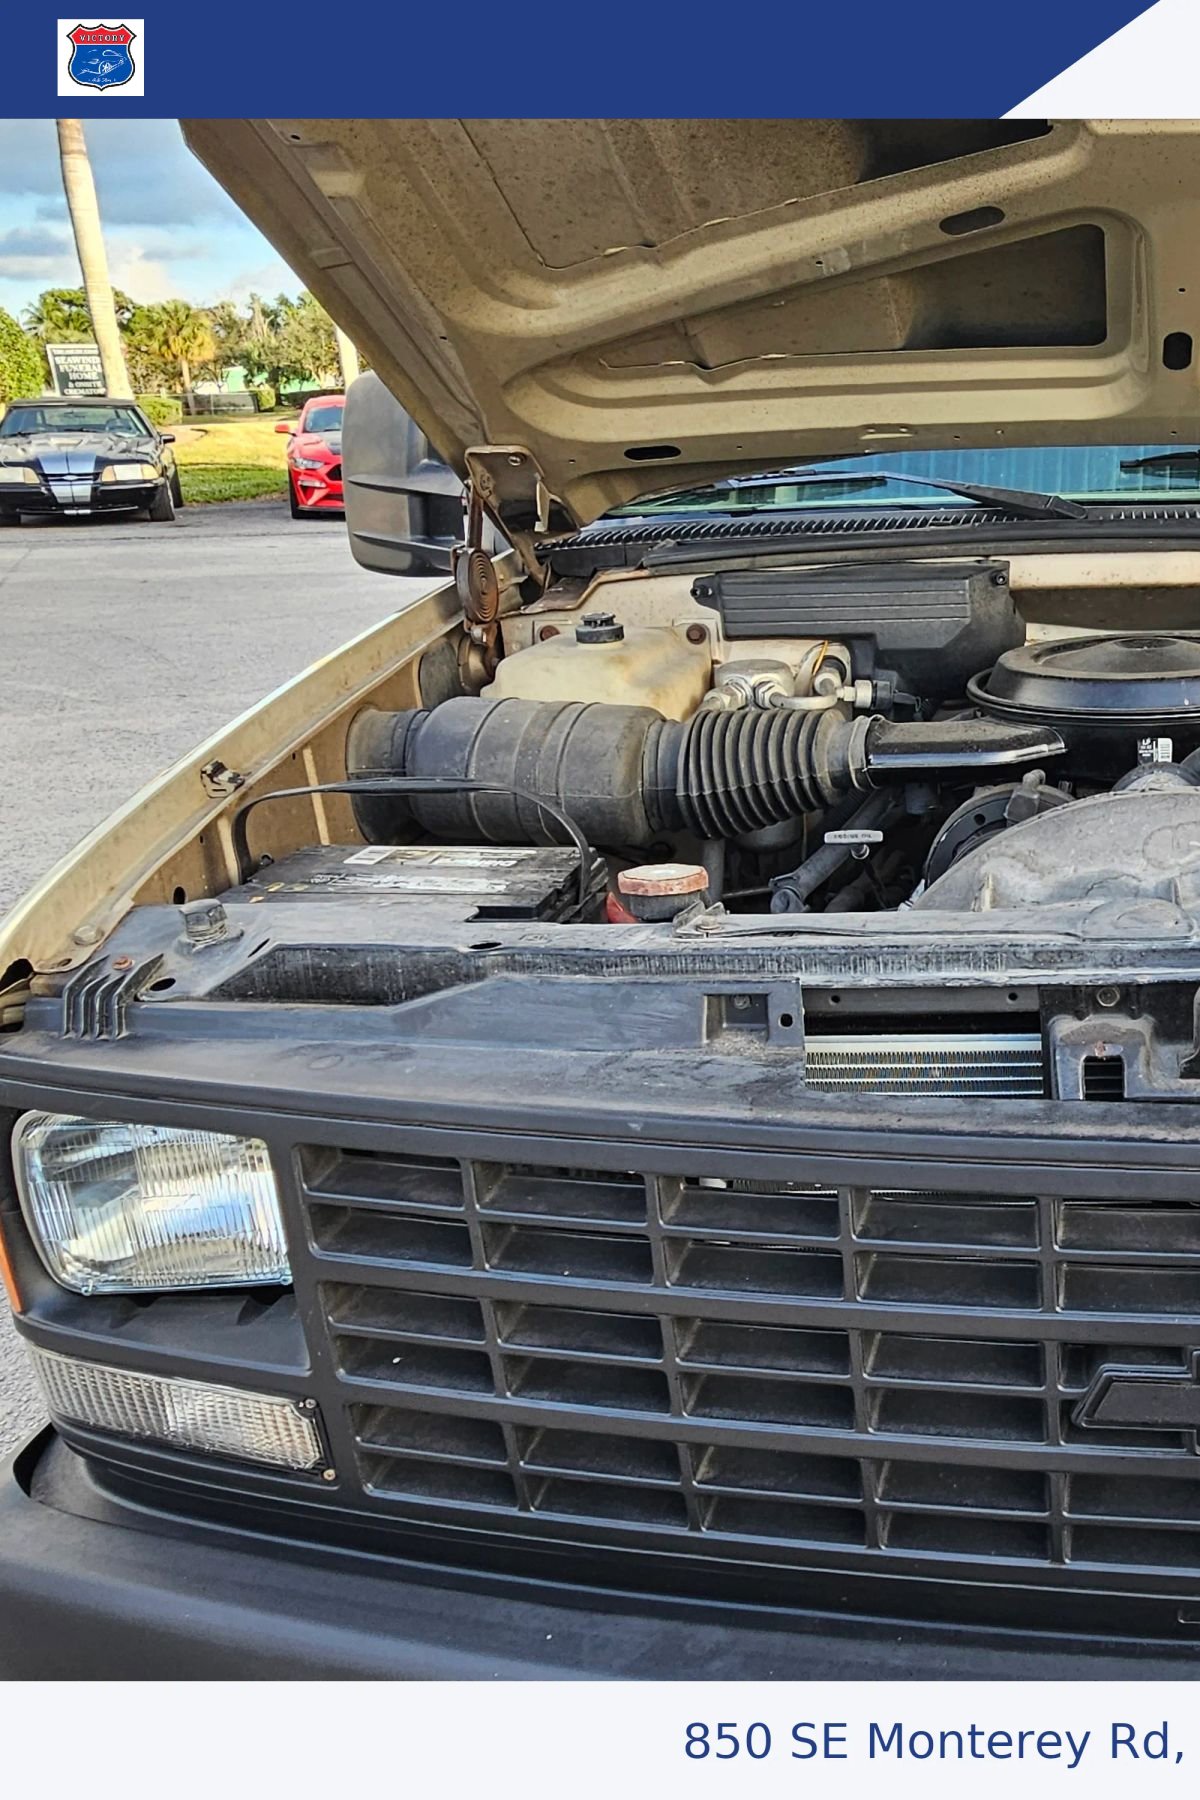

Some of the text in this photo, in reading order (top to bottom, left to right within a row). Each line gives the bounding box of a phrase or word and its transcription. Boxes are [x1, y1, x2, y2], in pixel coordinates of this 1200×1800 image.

[54, 356, 101, 365] SEAWIND
[59, 364, 103, 372] FUNERAL
[69, 372, 99, 380] HOME
